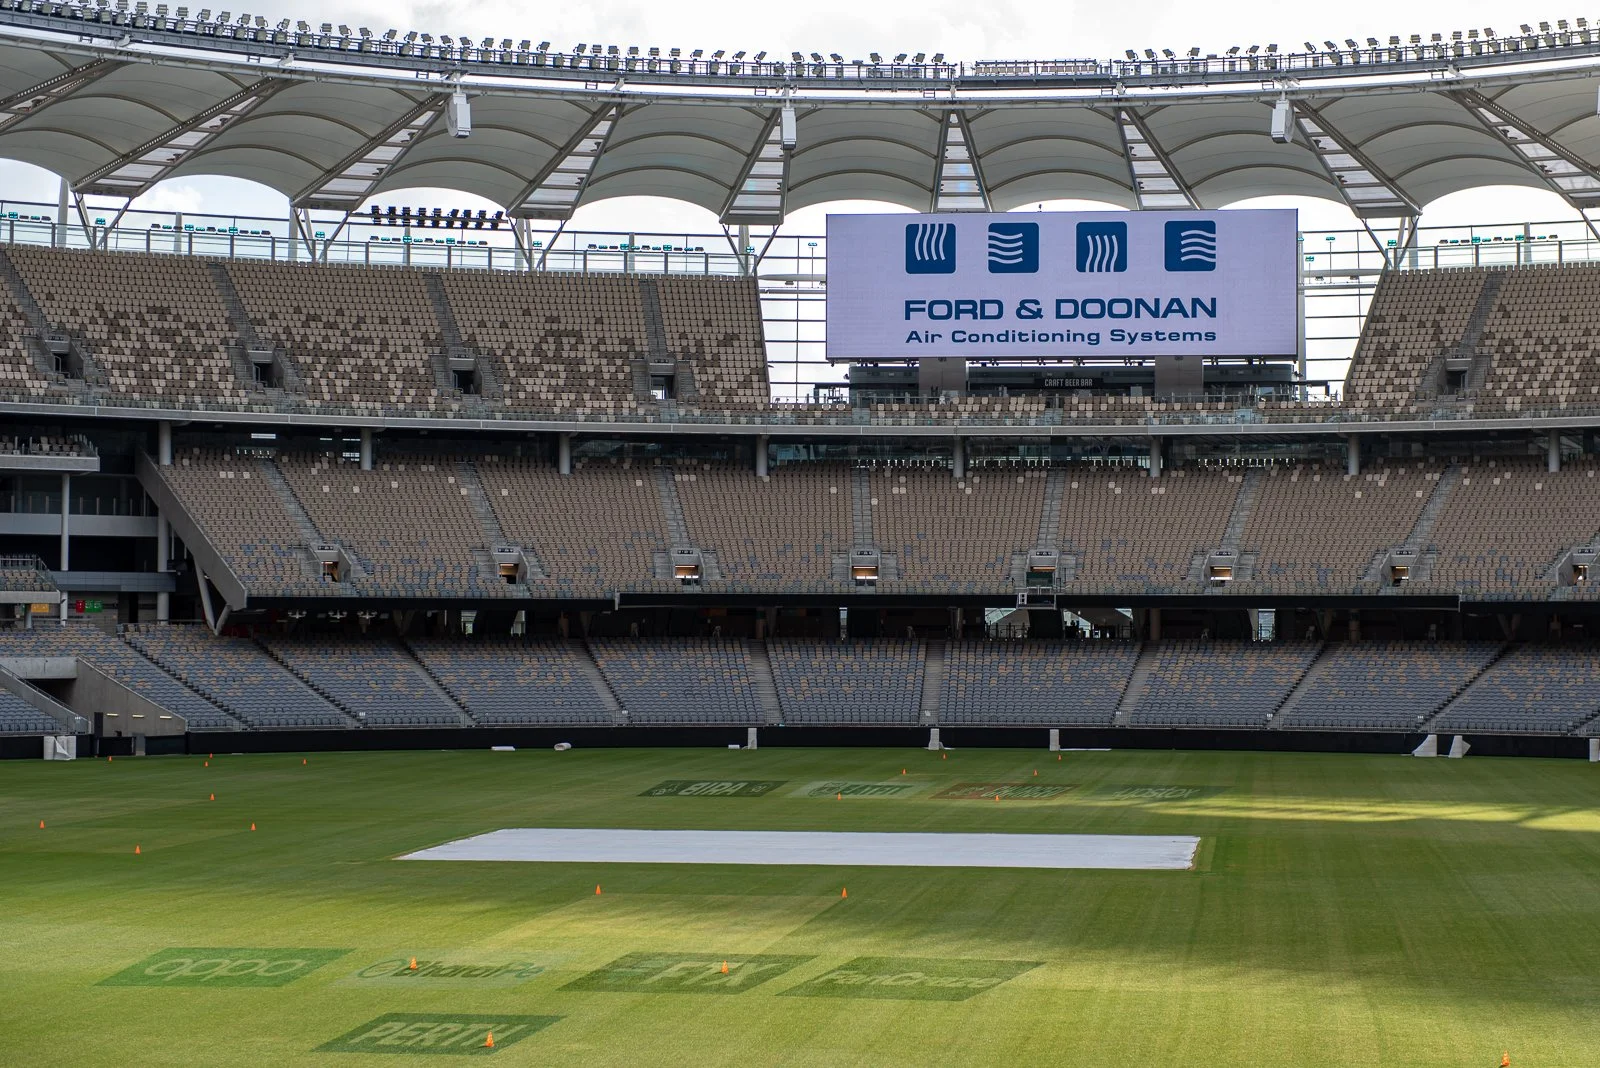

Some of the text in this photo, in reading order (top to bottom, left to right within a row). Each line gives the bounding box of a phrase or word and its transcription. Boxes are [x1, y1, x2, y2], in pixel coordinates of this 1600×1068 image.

[905, 297, 1217, 320] FORD & DOONAN
[905, 328, 1217, 346] Air Conditioning Systems
[1044, 378, 1093, 387] CRAFT BEER BAR
[678, 782, 748, 795] BIRA
[143, 958, 309, 982] oppo
[639, 961, 784, 986] FTX
[347, 1021, 530, 1046] PERTH
